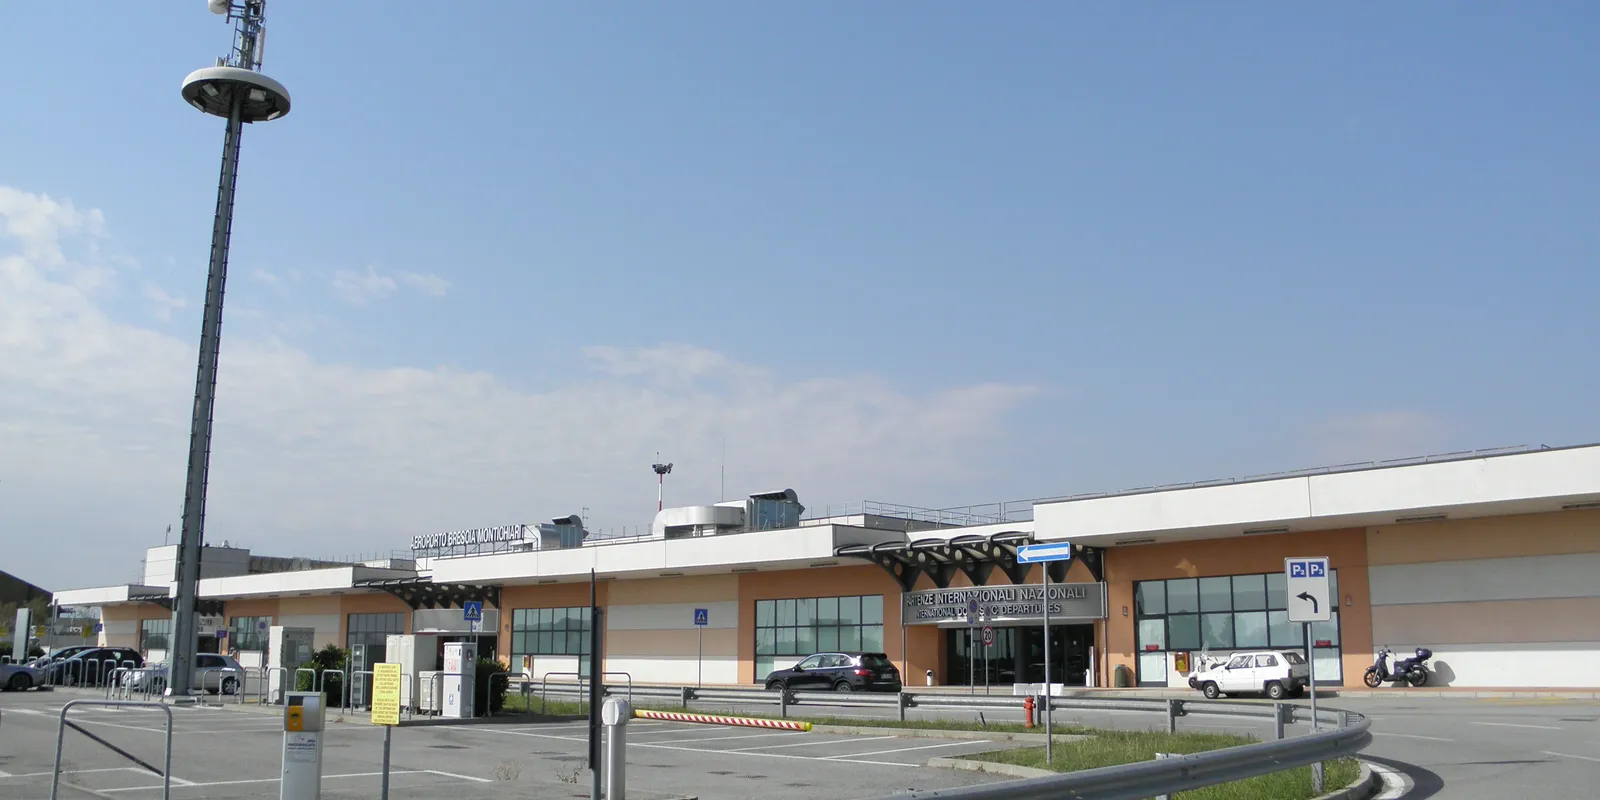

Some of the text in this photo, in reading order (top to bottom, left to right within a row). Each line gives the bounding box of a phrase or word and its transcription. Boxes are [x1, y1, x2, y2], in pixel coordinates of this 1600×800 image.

[410, 525, 523, 550] AEROPORTO BRESCIA MONTICHIARI
[1020, 587, 1085, 600] NAZONALI
[984, 630, 991, 640] 20
